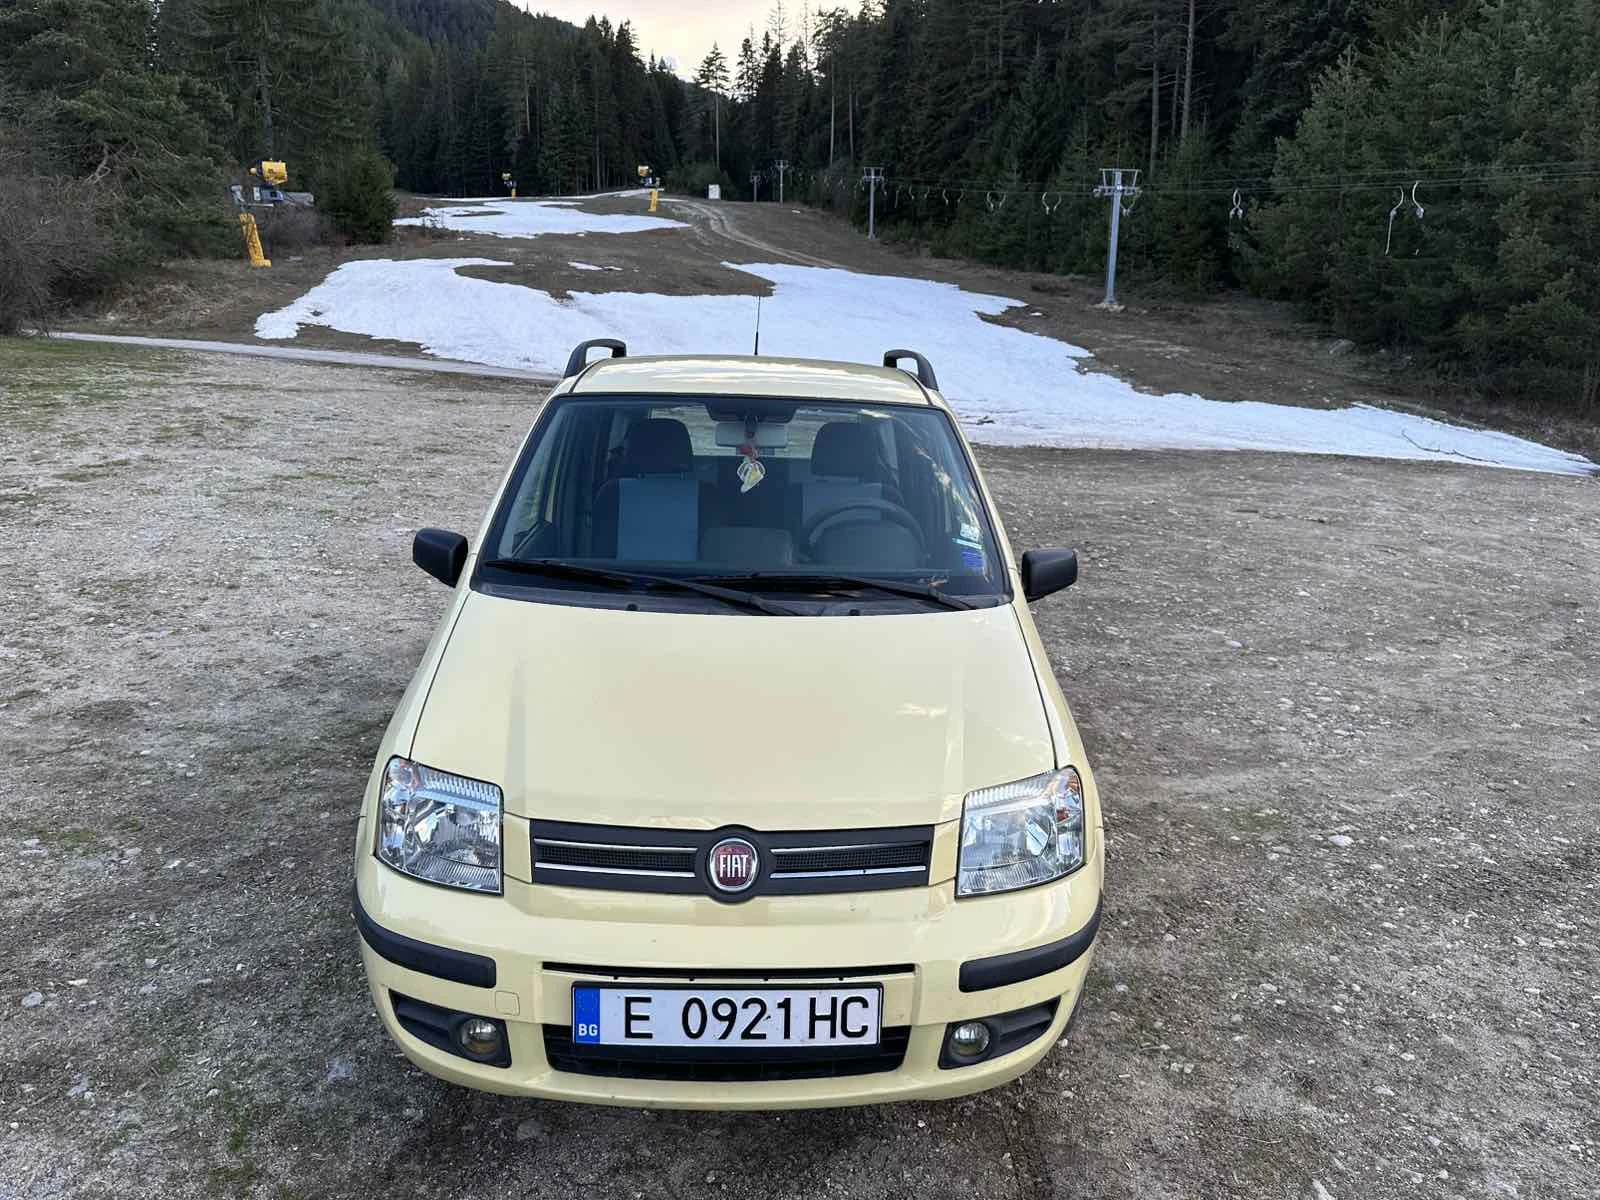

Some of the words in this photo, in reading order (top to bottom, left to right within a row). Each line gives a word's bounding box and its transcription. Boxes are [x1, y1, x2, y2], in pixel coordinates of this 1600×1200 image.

[719, 854, 750, 878] FIAT
[578, 1023, 598, 1037] BG
[624, 996, 653, 1040] E
